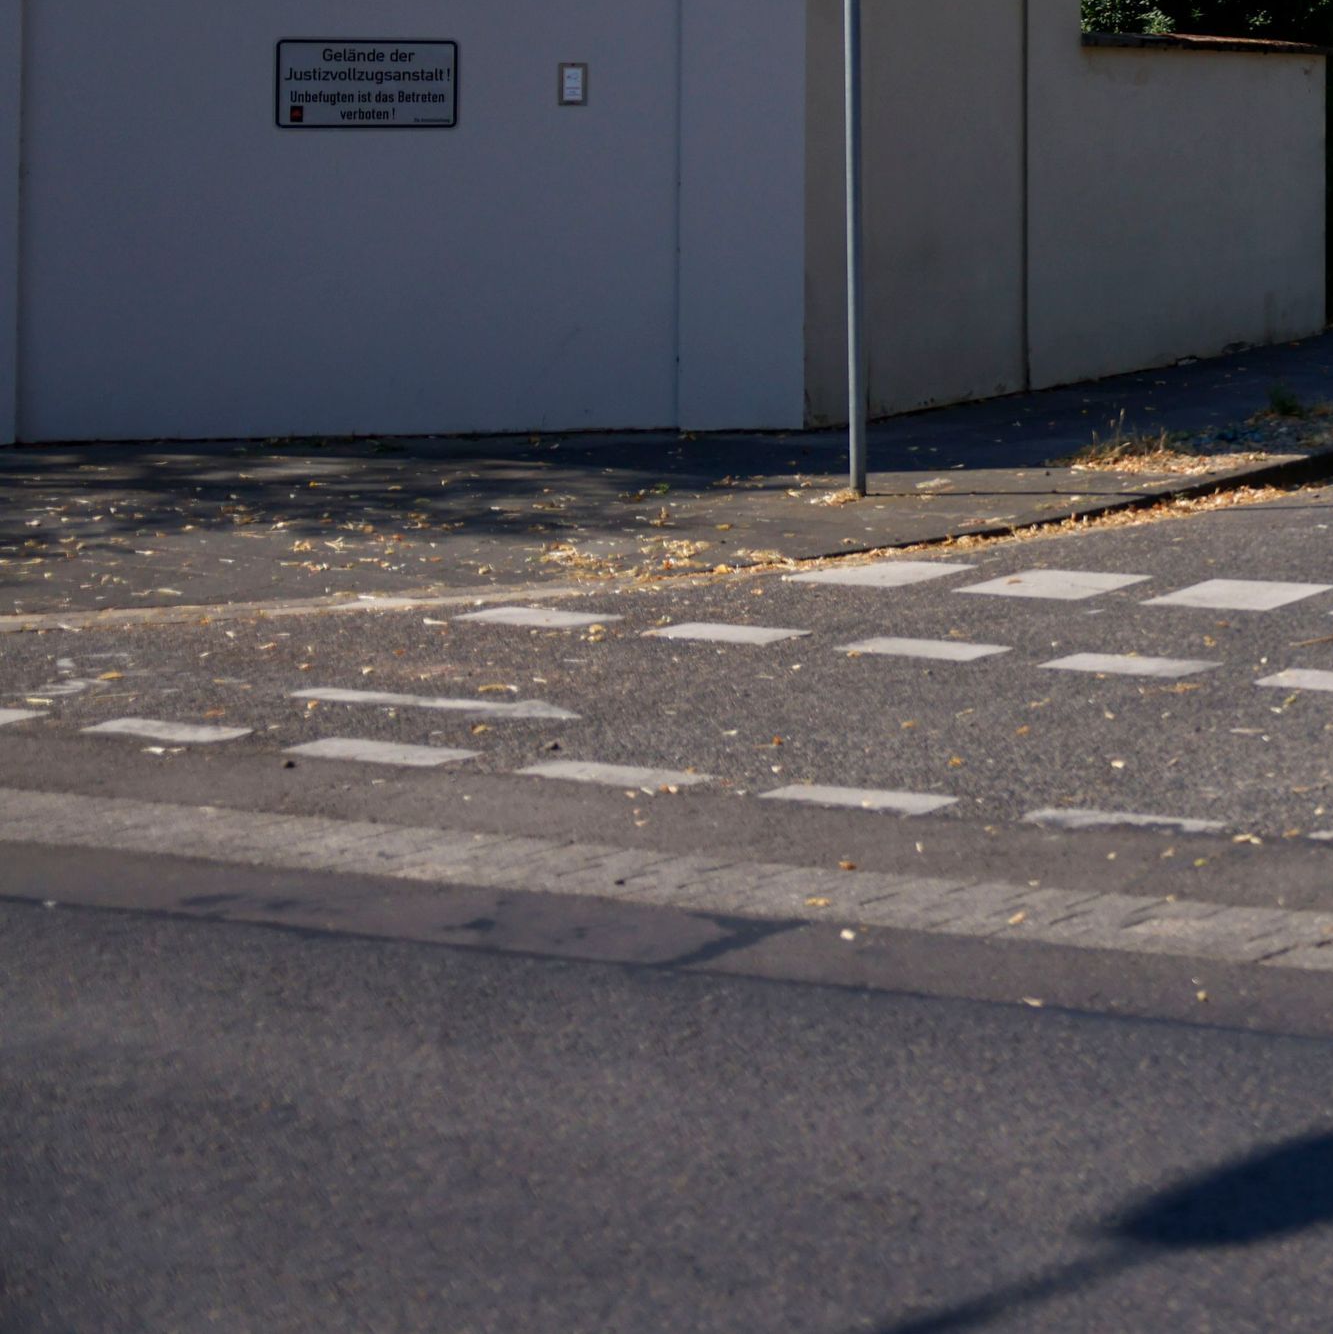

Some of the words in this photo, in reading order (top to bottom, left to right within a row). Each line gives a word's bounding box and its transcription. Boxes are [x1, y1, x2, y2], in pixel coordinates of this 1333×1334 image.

[322, 48, 385, 62] Gelände
[390, 49, 415, 62] der
[290, 90, 354, 105] Unbefugten
[357, 91, 371, 103] ist
[375, 91, 394, 103] das
[398, 91, 445, 103] Betreten
